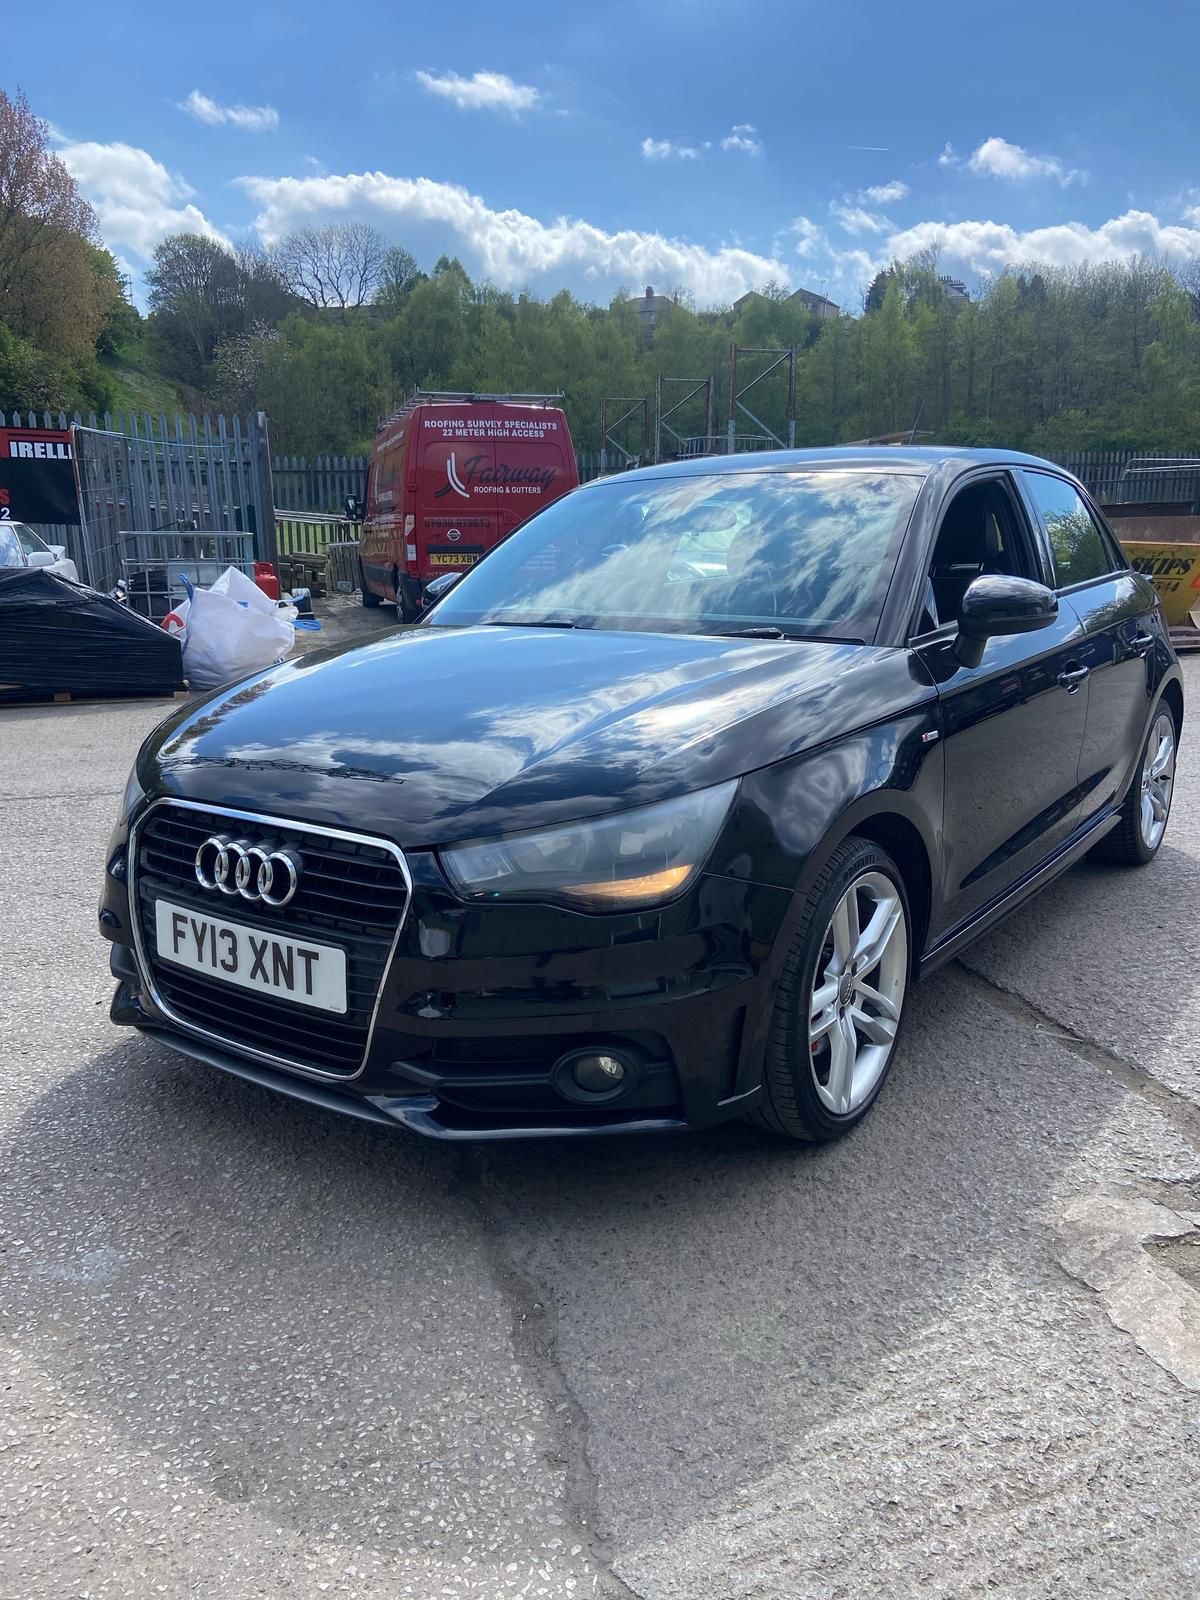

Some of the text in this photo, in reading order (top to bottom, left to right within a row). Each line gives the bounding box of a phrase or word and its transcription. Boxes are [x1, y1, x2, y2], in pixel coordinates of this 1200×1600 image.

[424, 420, 557, 430] ROOFING SURVEY SPECIALISTS
[455, 429, 485, 437] METER
[487, 429, 509, 437] HIGH
[511, 429, 544, 438] ACCESS
[464, 455, 556, 491] Fairway
[474, 486, 541, 494] ROOFING & GUTTERS
[437, 554, 459, 563] YC73
[1131, 557, 1195, 575] SKIPS
[171, 911, 320, 996] FY13 XNT
